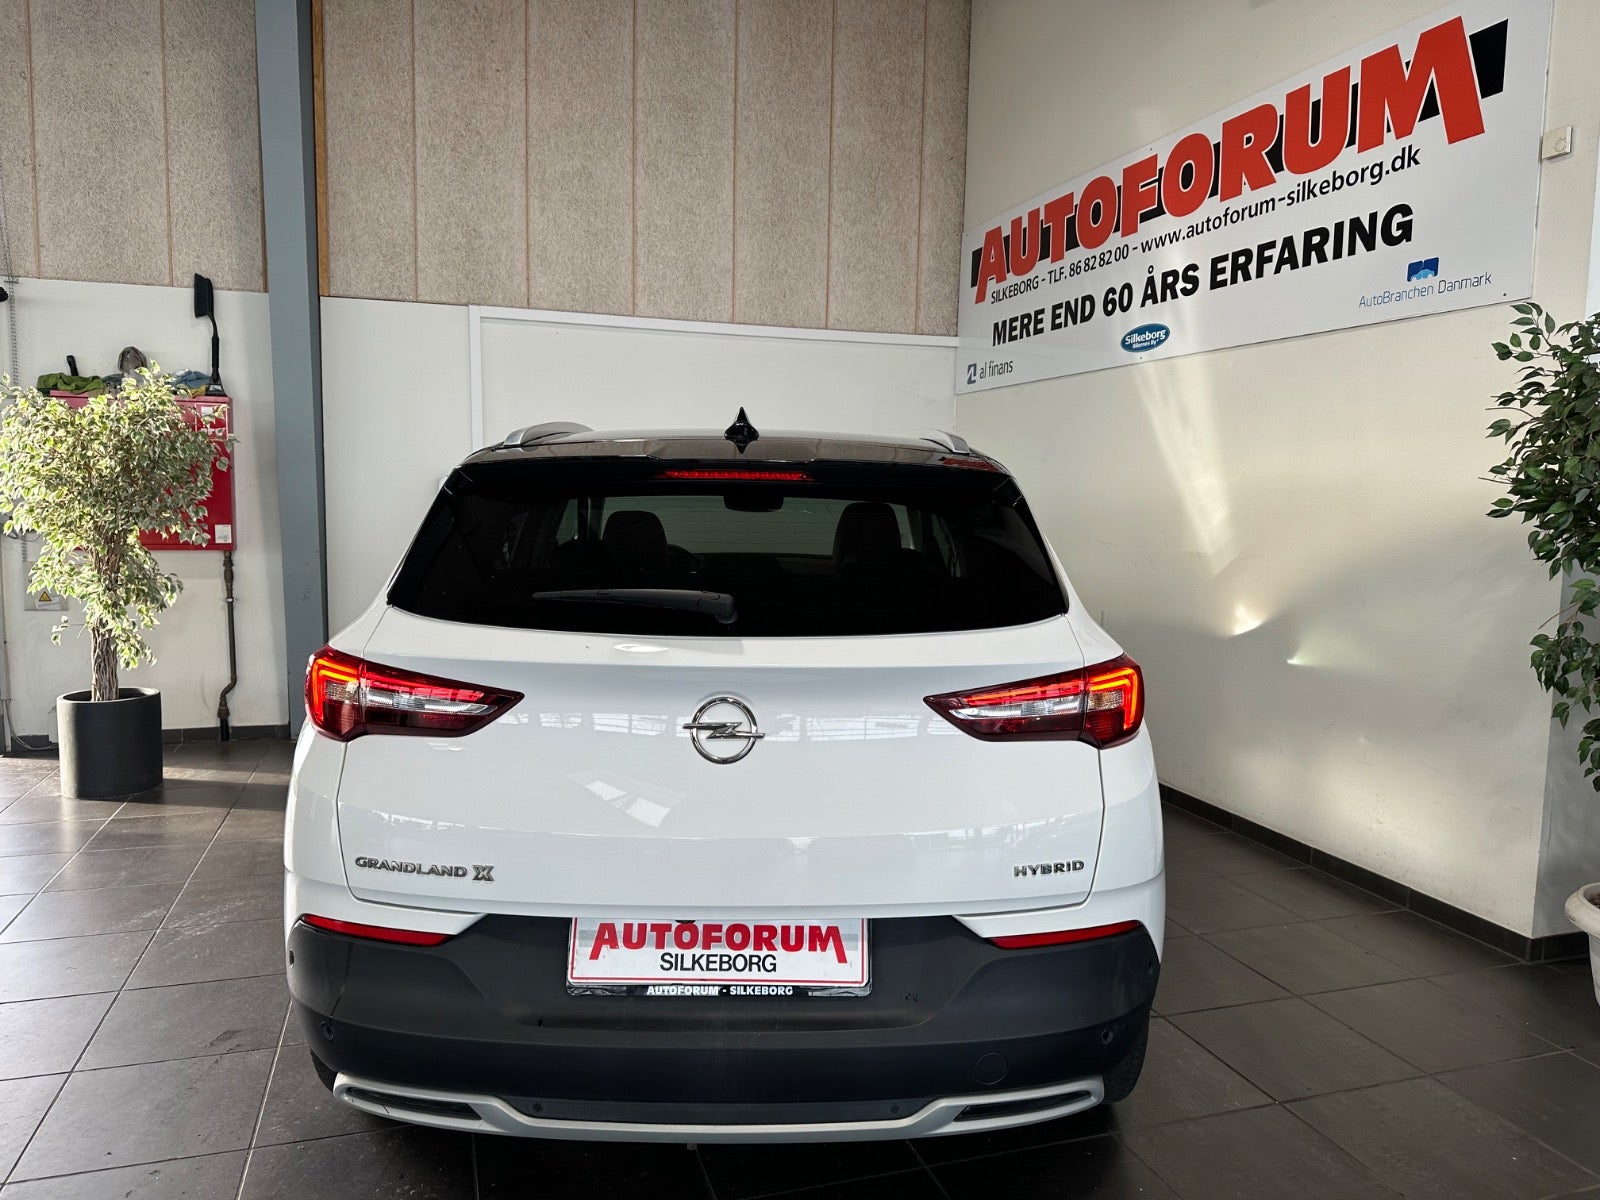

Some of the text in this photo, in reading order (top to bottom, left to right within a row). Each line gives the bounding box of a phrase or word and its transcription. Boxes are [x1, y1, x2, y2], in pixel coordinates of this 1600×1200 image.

[975, 15, 1485, 304] AUTOFORUM
[991, 275, 1039, 305] SILKEBORG
[1048, 266, 1067, 285] TLF.
[1069, 260, 1082, 278] 86
[1140, 144, 1421, 254] www.autoforum-silkeborg.dk
[992, 203, 1415, 347] MERE END 60 ÅRS ERFARING
[1358, 271, 1493, 308] AutoBranchen Danmark
[1125, 329, 1166, 345] Silkeborg
[979, 360, 1014, 379] al finans
[355, 856, 496, 882] GRANDLAND X
[1013, 860, 1085, 877] HYBRID
[589, 923, 848, 964] AUTOFORUM
[659, 952, 778, 973] SILKEBORG
[647, 985, 719, 996] AUTOFORUM
[729, 985, 793, 996] SILKEBORG
